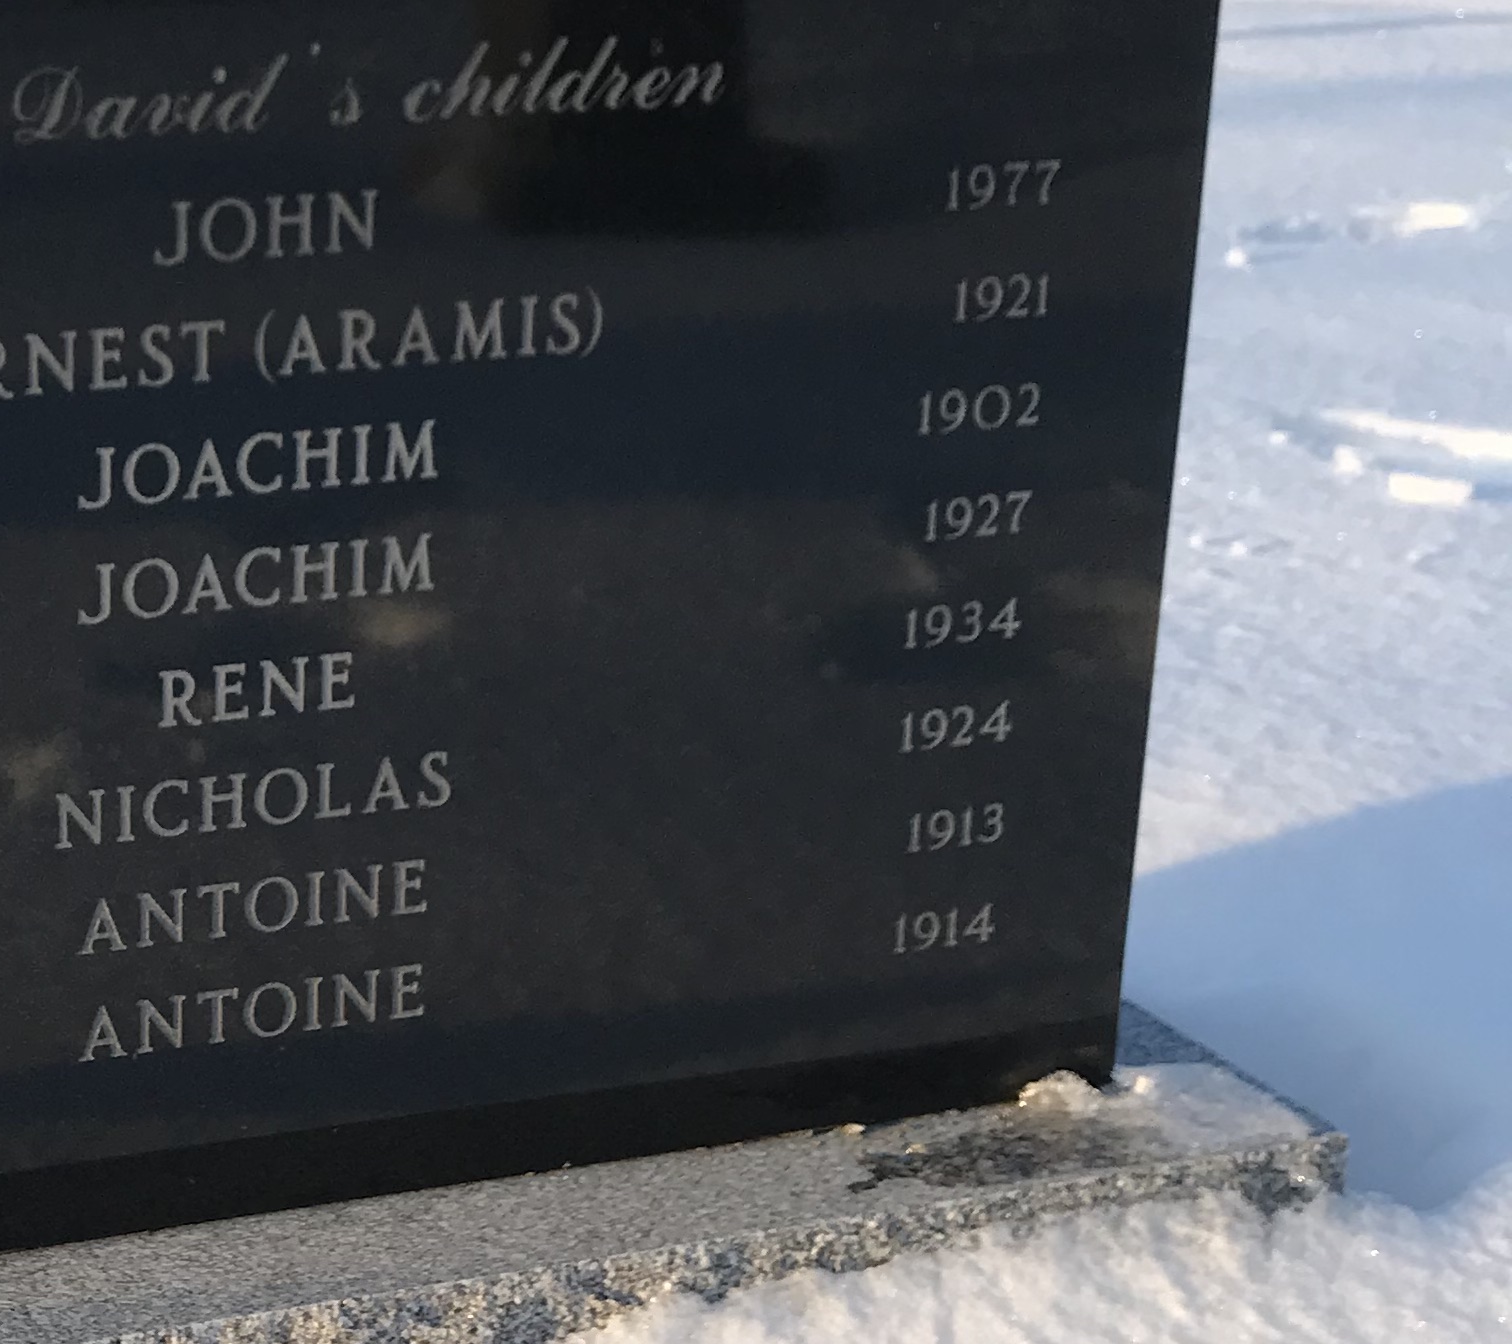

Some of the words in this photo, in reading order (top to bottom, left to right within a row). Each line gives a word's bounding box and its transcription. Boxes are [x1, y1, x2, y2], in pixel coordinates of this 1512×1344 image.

[403, 34, 726, 123] children
[945, 158, 1062, 212] 1977
[153, 188, 379, 267] JOHN
[253, 288, 604, 384] (ARAMIS)
[954, 271, 1050, 323] 1921
[918, 381, 1042, 436] 1902
[76, 417, 440, 511] JOACHIM
[924, 488, 1034, 543] 1927
[76, 531, 436, 627] JOACHIM
[903, 596, 1023, 650] 1934
[157, 650, 357, 729] RENE
[899, 698, 1014, 754] 1924
[53, 749, 453, 851] NICHOLAS
[905, 801, 1005, 854] 1913
[76, 857, 429, 956] ANTOINE
[892, 902, 997, 955] 1914
[77, 962, 426, 1063] ANTOINE
